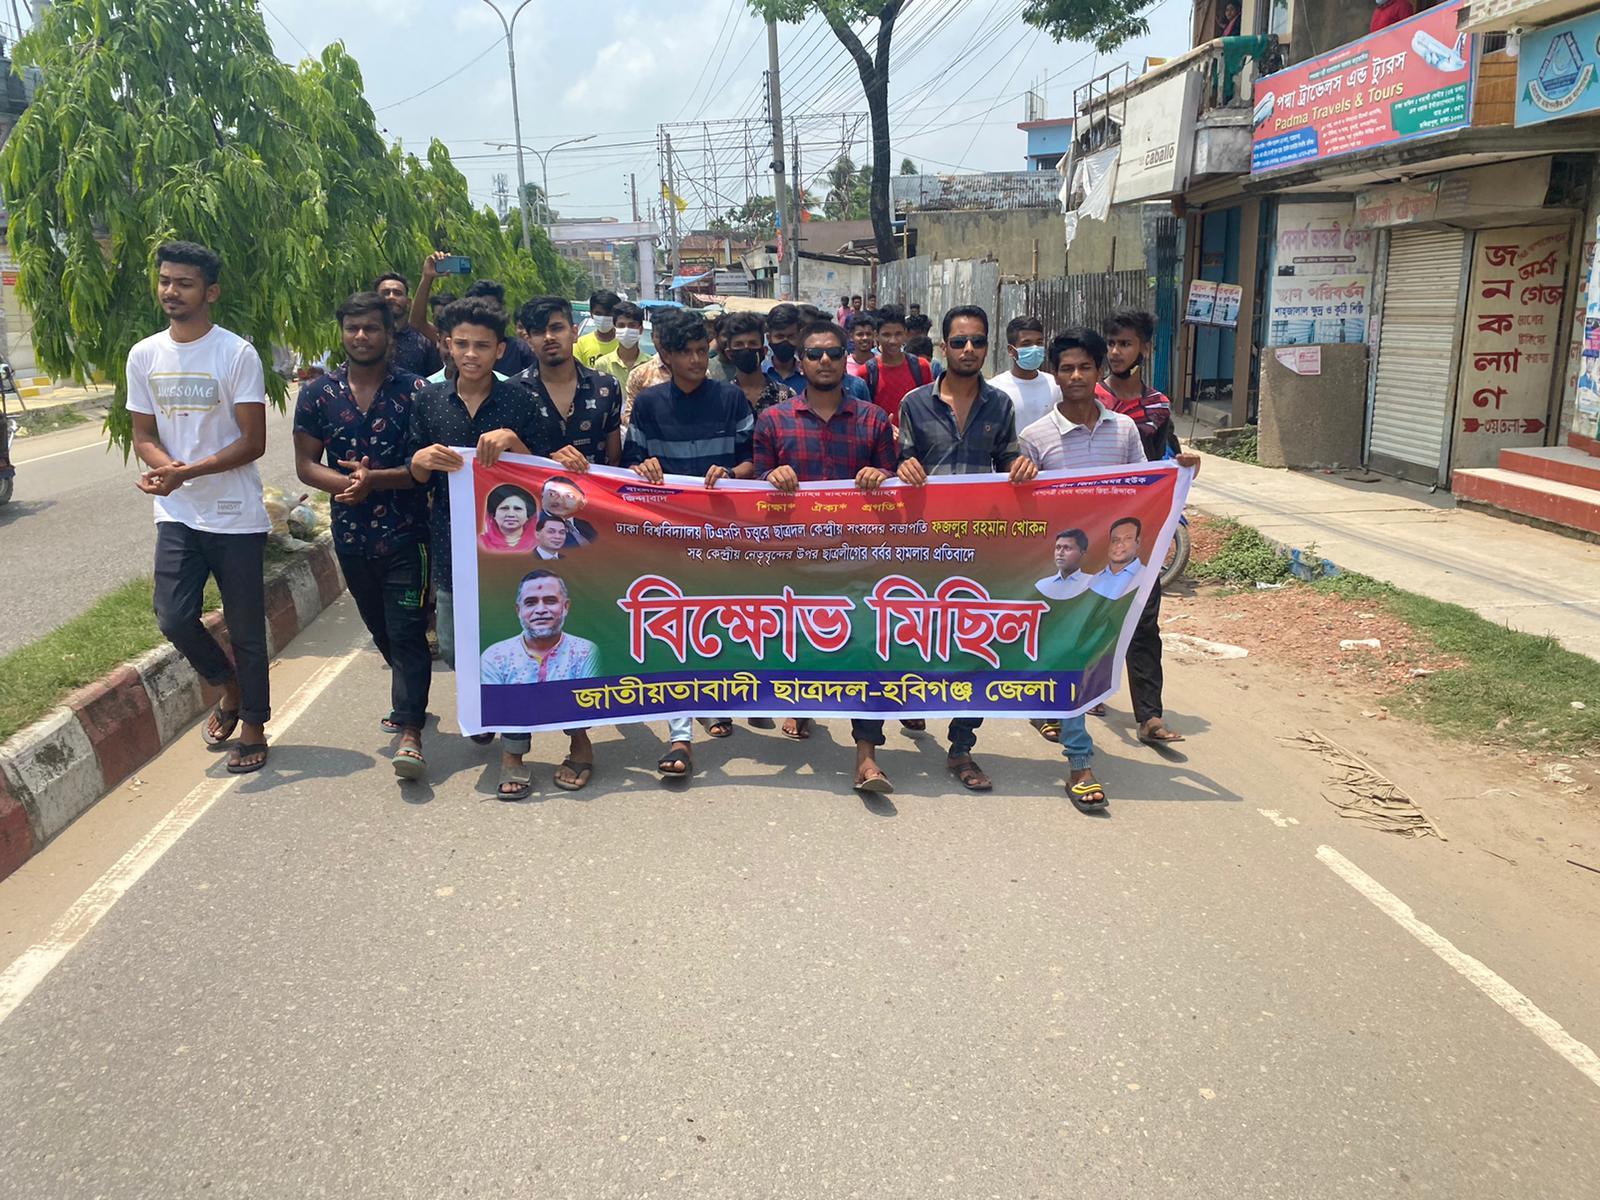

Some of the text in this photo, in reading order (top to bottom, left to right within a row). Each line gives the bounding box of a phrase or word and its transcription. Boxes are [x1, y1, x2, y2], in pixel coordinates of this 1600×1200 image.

[1274, 112, 1309, 131] Padma
[1311, 98, 1351, 121] Travels
[1354, 92, 1364, 108] &
[1367, 82, 1404, 104] Tours
[1277, 91, 1296, 110] পদ্মা
[1145, 144, 1175, 166] caballo
[1518, 249, 1558, 281] অর্শ
[1308, 281, 1365, 301] পরিবর্তন
[1520, 283, 1564, 306] গেজ
[615, 522, 640, 536] ঢাকা
[642, 520, 702, 540] বিশ্ববিদ্যালয়
[704, 522, 742, 541] টিএসসি
[772, 524, 806, 541] ছাত্রদল
[809, 521, 844, 540] কেন্দ্রীয়
[847, 522, 886, 535] সংসদের
[889, 519, 928, 535] সভাপতি
[931, 519, 968, 539] ফজলুর
[972, 519, 1008, 537] রহমান
[1010, 519, 1048, 537] খোকন
[687, 542, 976, 565] সহ কেন্দ্রীয় নেতৃবৃন্দের উপর ছাত্রলীগের বর্বর হামলার প্রতিবাদে
[617, 574, 1051, 668] বিক্ষোভ মিছিল
[572, 672, 762, 711] জাতীয়তাবাদী
[770, 673, 973, 705] ছাত্রদল-হবিগঞ্জ
[985, 678, 1058, 703] জেলা
